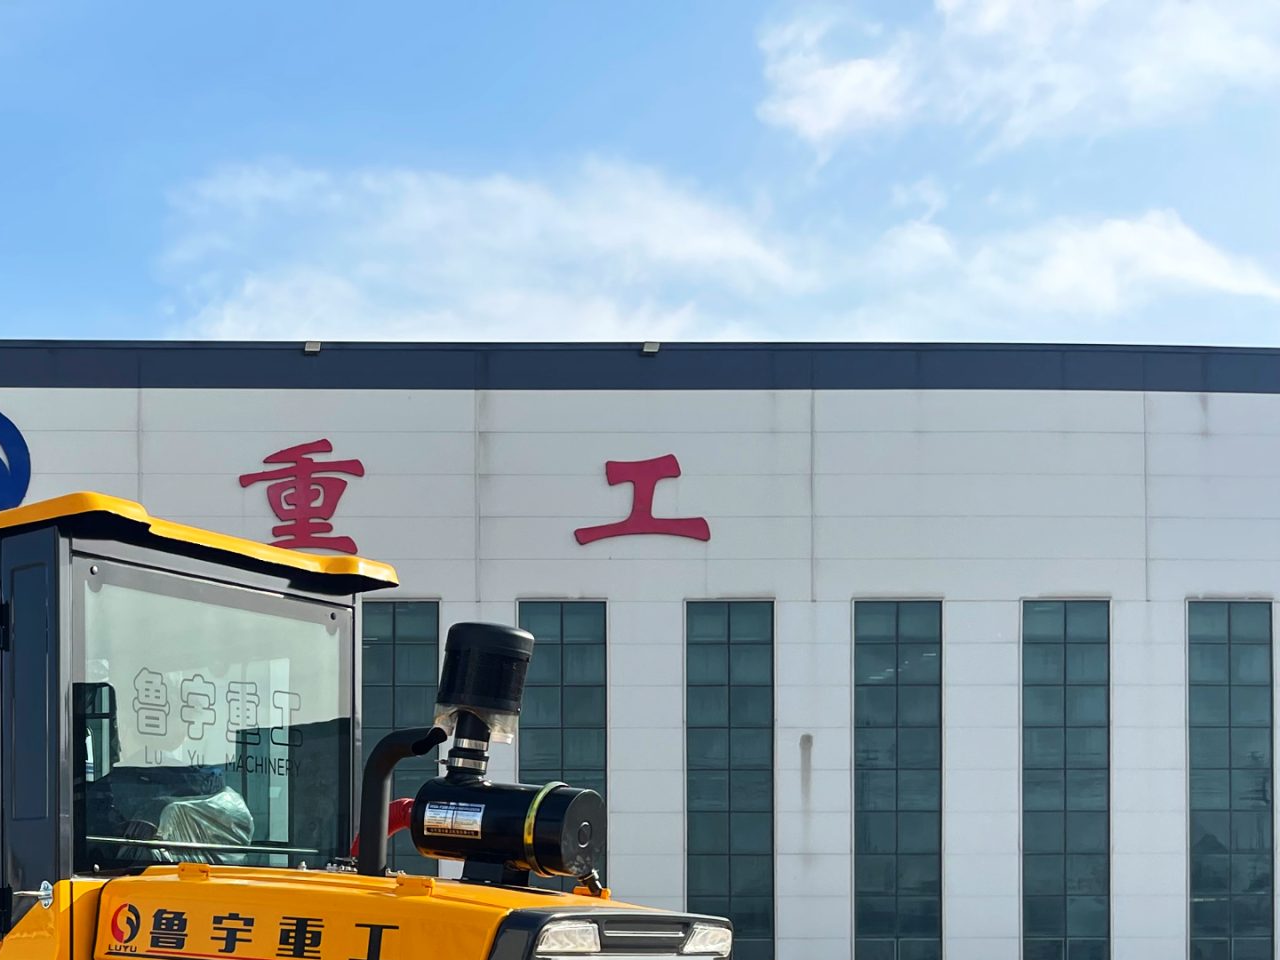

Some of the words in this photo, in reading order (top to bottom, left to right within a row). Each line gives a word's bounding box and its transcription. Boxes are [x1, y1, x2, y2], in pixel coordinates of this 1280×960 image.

[132, 667, 304, 747] 鲁宇重工
[144, 745, 163, 765] LU
[186, 749, 206, 769] YU
[225, 752, 303, 776] MACHINERY
[108, 943, 138, 953] LUYU
